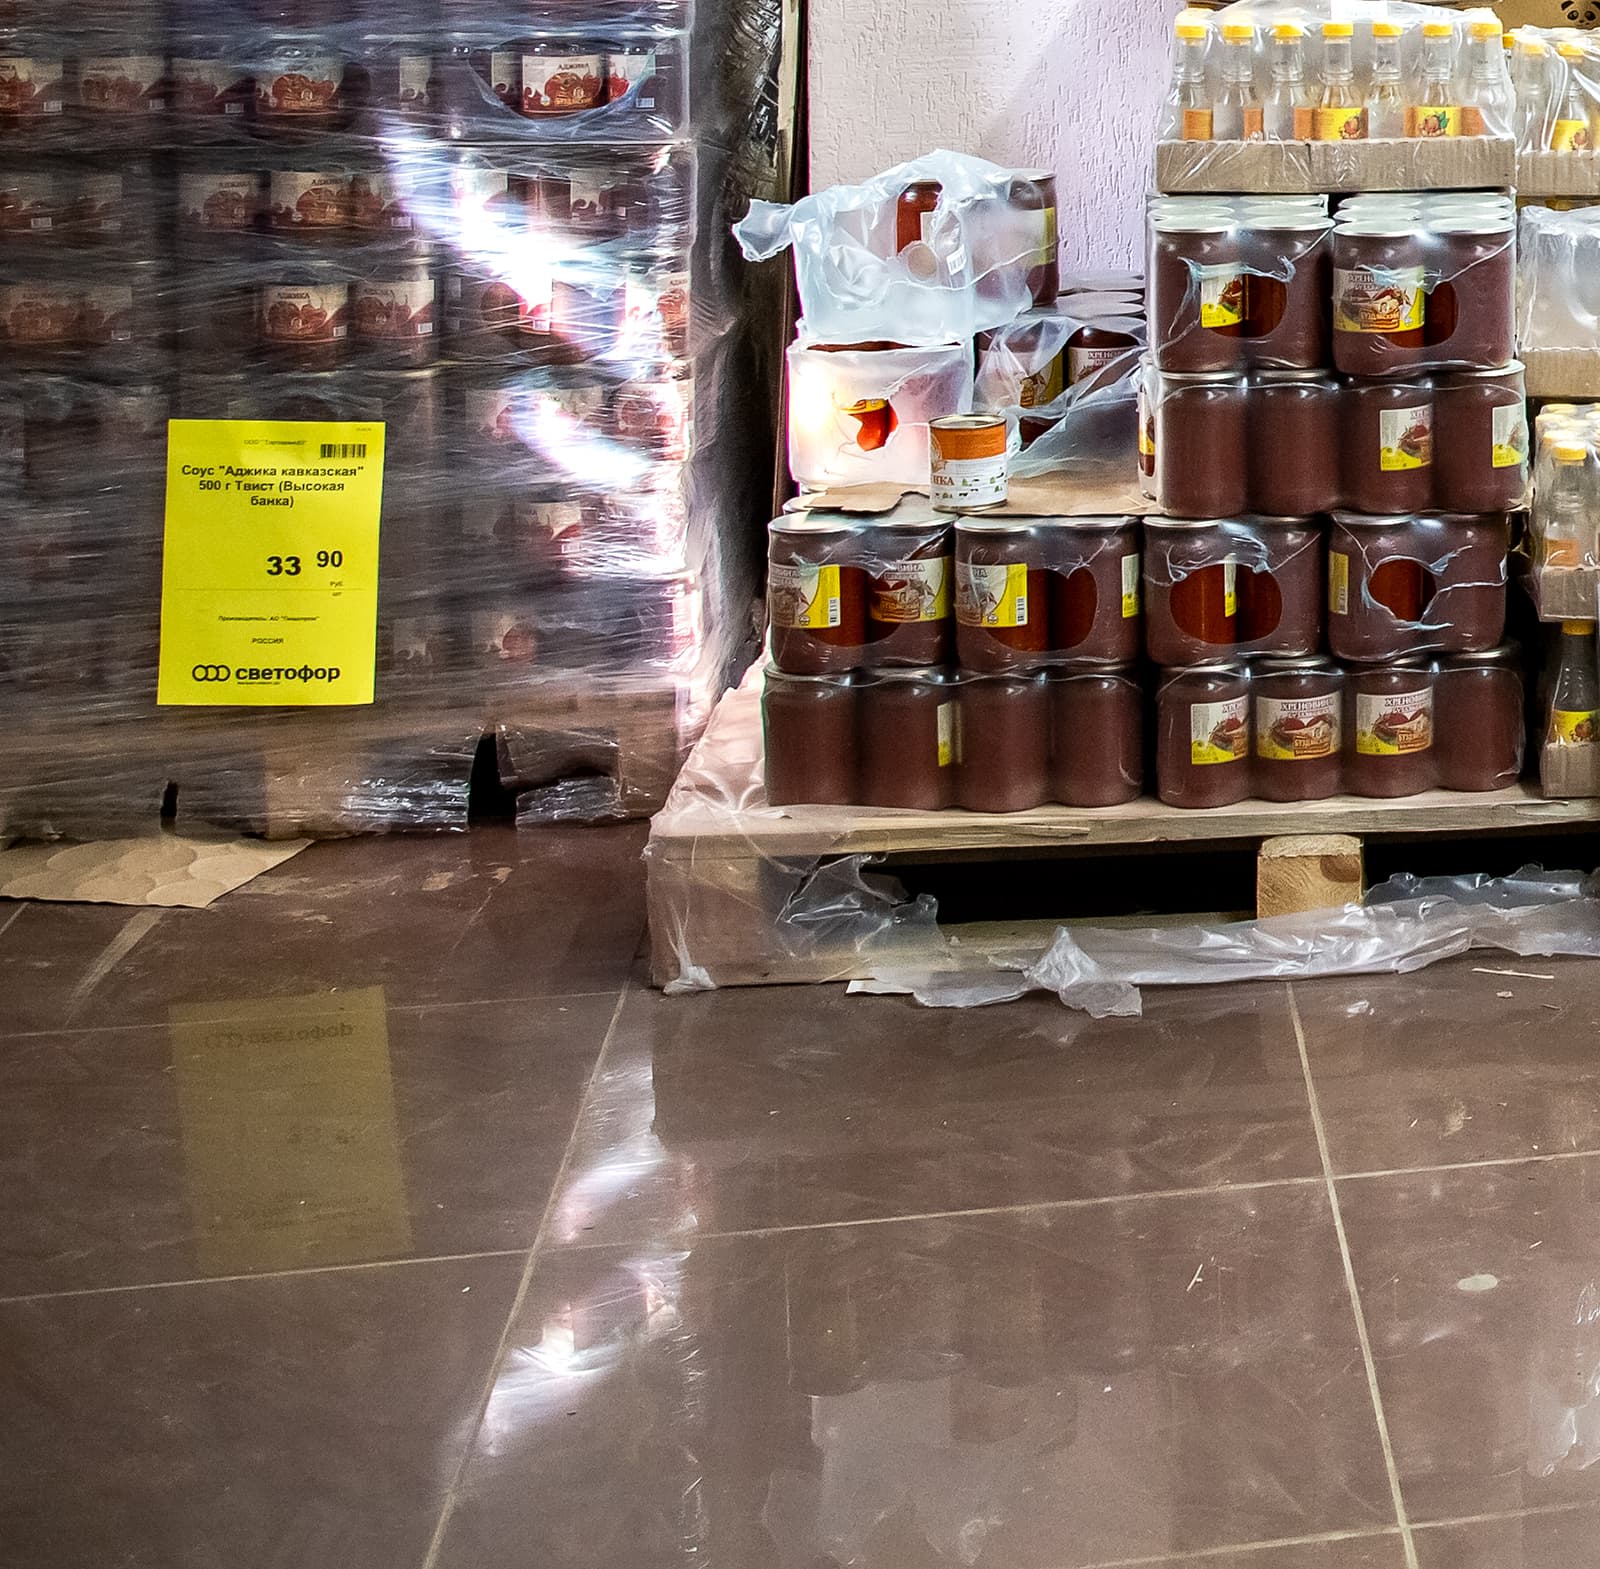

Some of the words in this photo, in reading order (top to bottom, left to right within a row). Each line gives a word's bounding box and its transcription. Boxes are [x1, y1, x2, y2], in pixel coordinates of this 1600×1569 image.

[182, 465, 215, 477] Соус
[219, 465, 277, 477] "Аджика
[281, 466, 364, 477] кавказская"
[199, 480, 221, 491] 500
[225, 483, 230, 491] г
[235, 481, 274, 491] Твист
[279, 481, 344, 493] (Высокая
[250, 495, 294, 508] банка)
[266, 556, 301, 576] 33
[316, 550, 343, 568] 90
[236, 666, 341, 682] светофор
